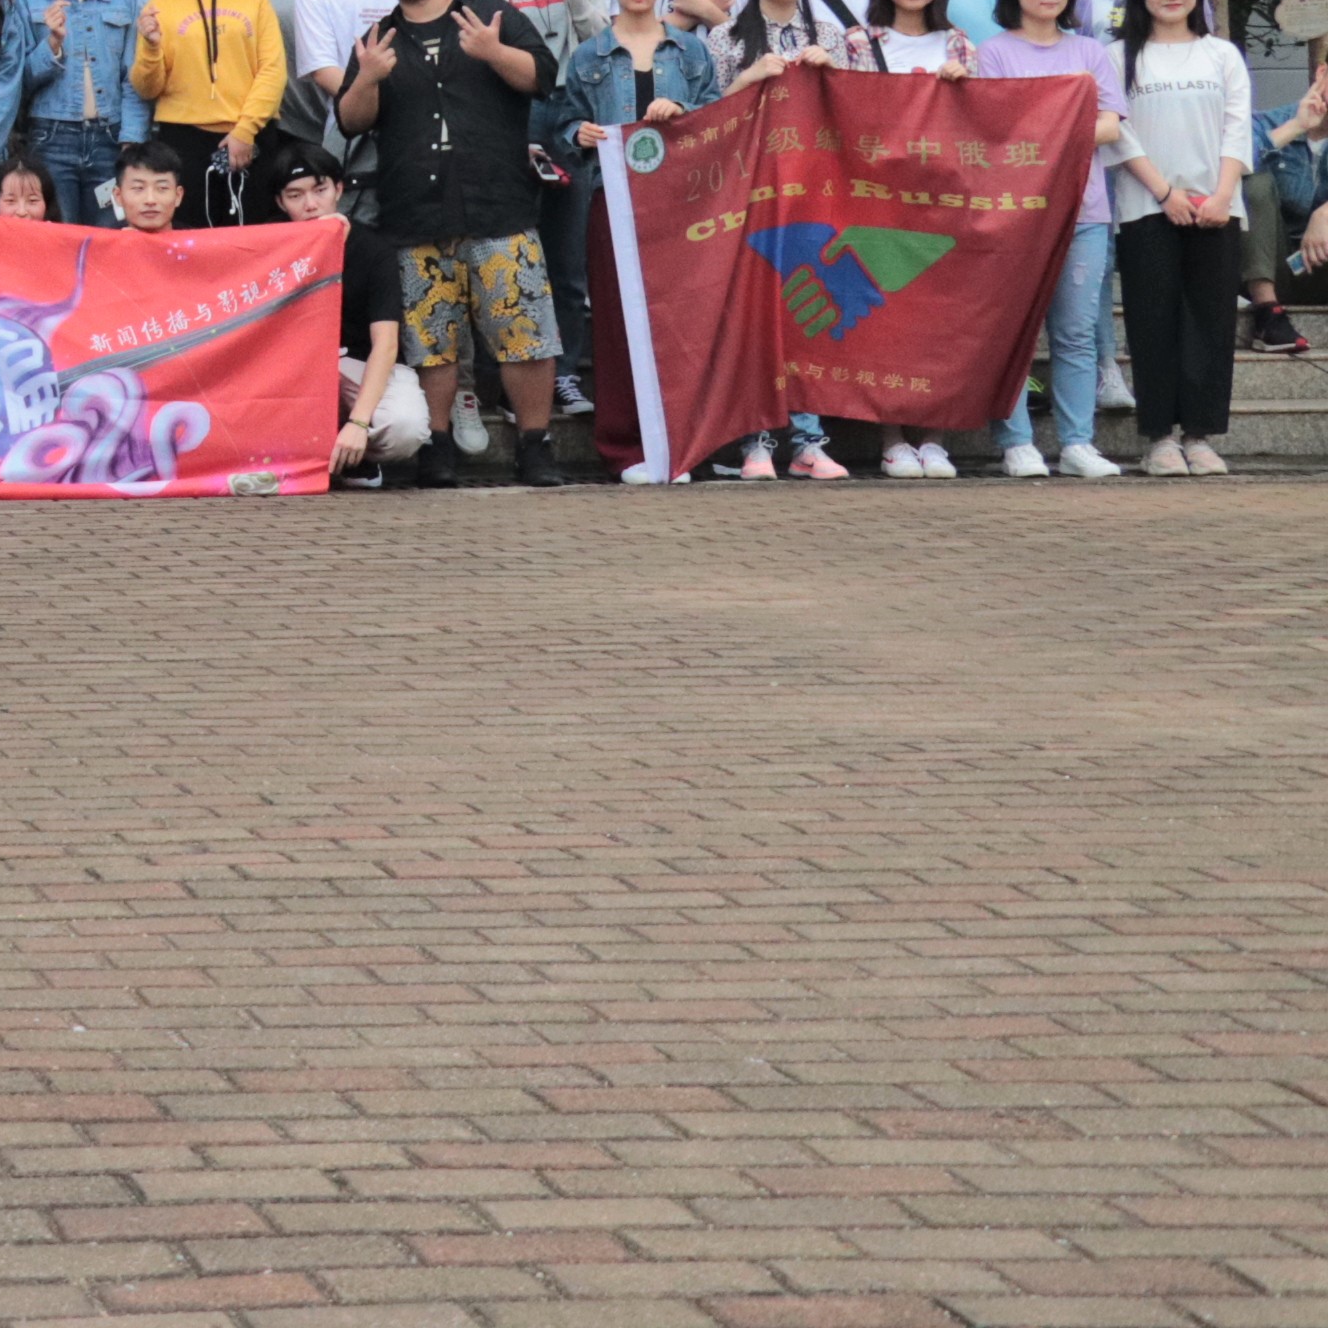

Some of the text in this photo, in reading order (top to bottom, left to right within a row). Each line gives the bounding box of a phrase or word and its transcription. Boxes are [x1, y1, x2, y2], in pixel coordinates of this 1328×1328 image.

[685, 180, 808, 242] Chna
[849, 177, 1048, 212] Russia
[89, 256, 318, 354] 新闻传播与影视学院
